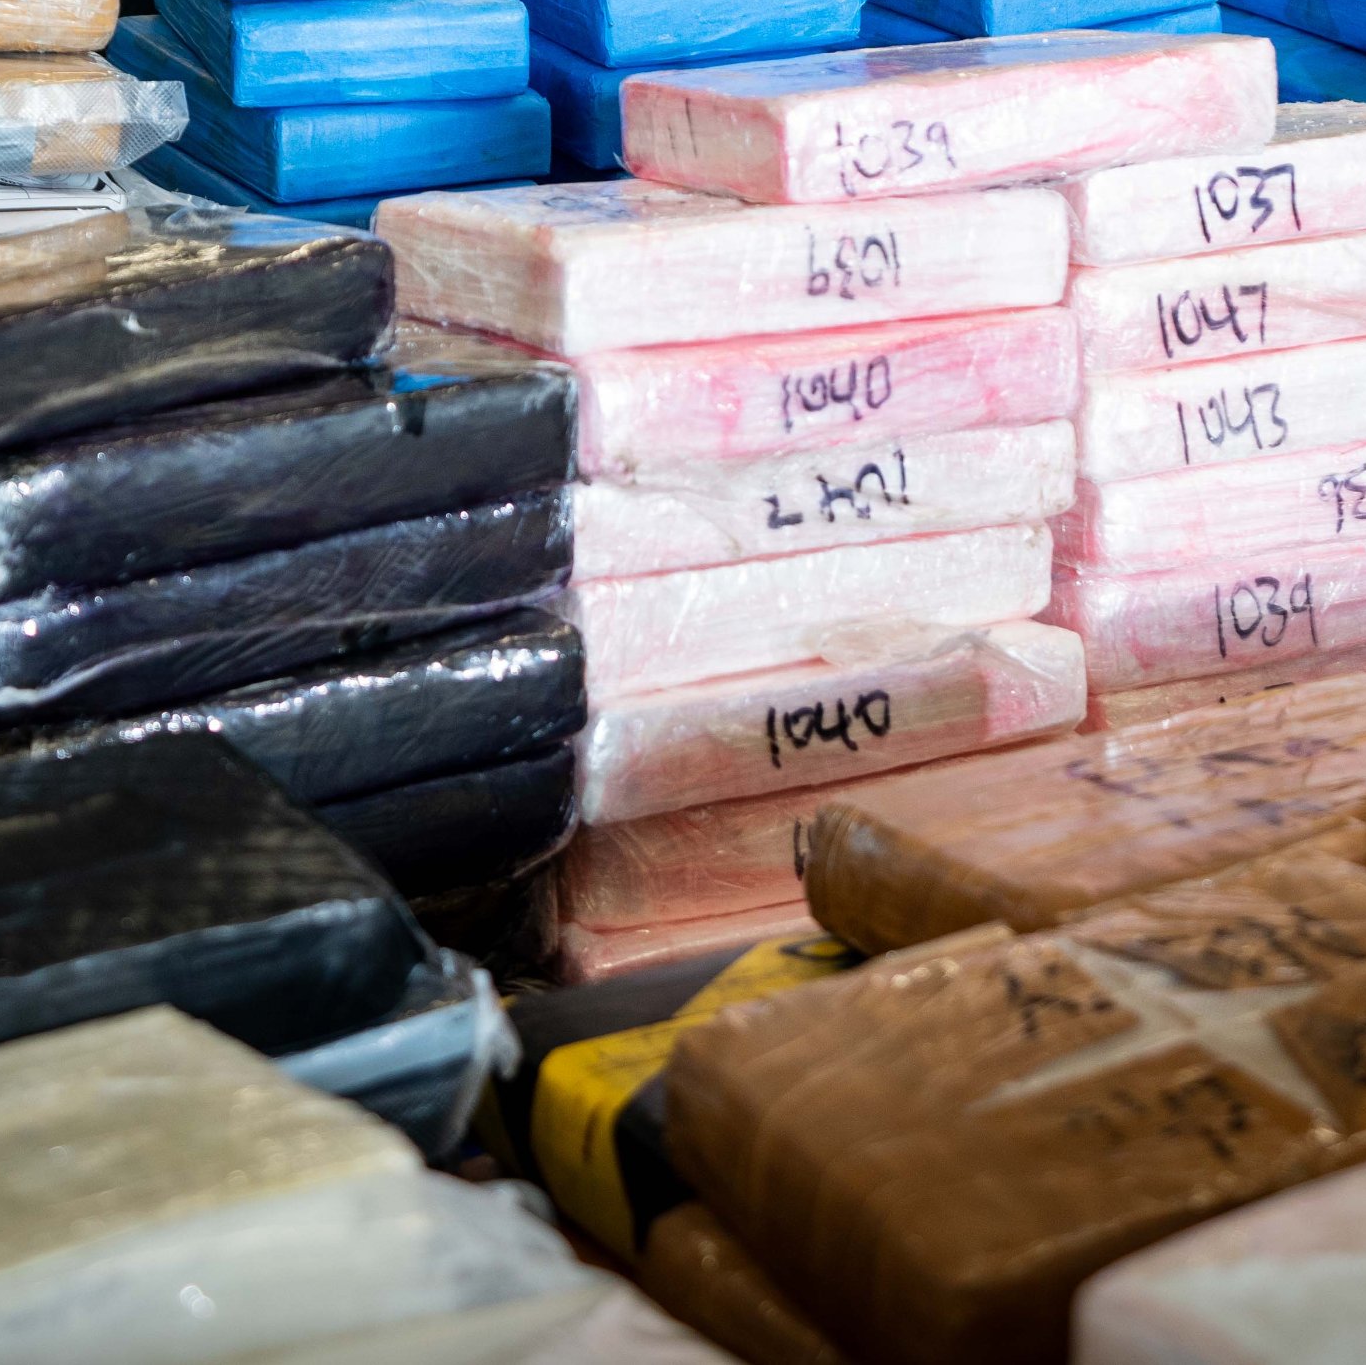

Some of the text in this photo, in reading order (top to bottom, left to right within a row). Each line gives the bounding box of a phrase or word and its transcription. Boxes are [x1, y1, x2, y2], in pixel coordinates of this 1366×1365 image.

[835, 121, 957, 194] 1039
[1195, 164, 1302, 243] 1037
[1157, 282, 1269, 358] 1047
[782, 355, 891, 434] 1040
[1178, 382, 1288, 465] 1043
[764, 689, 891, 769] 1040
